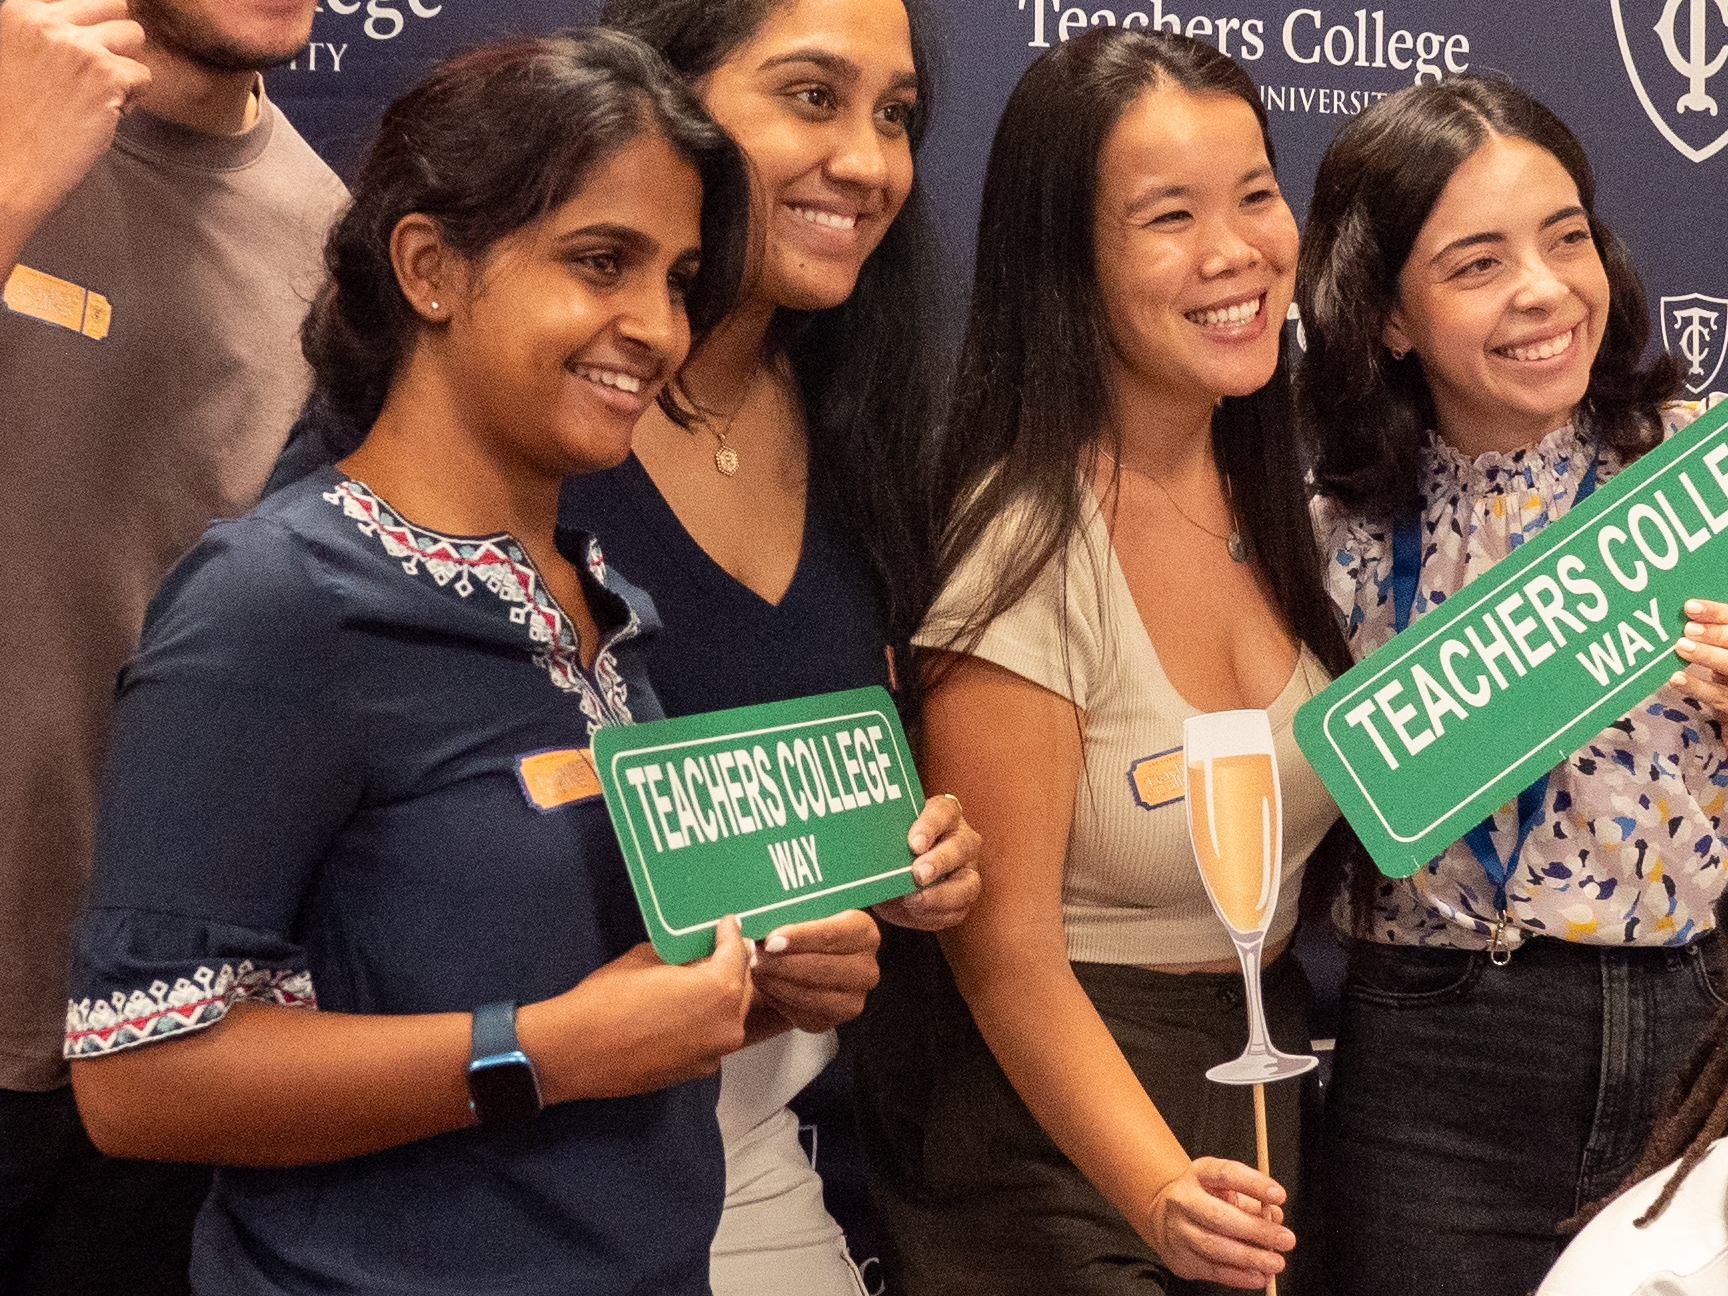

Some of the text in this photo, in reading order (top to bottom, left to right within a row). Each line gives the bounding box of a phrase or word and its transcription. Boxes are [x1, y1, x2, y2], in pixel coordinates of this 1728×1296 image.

[1282, 8, 1470, 87] College
[1344, 554, 1609, 772] TEACHERS
[1575, 596, 1672, 689] WAY
[626, 744, 787, 853] TEACHERS
[777, 725, 902, 823] COLLEGE
[768, 834, 823, 891] WAY
